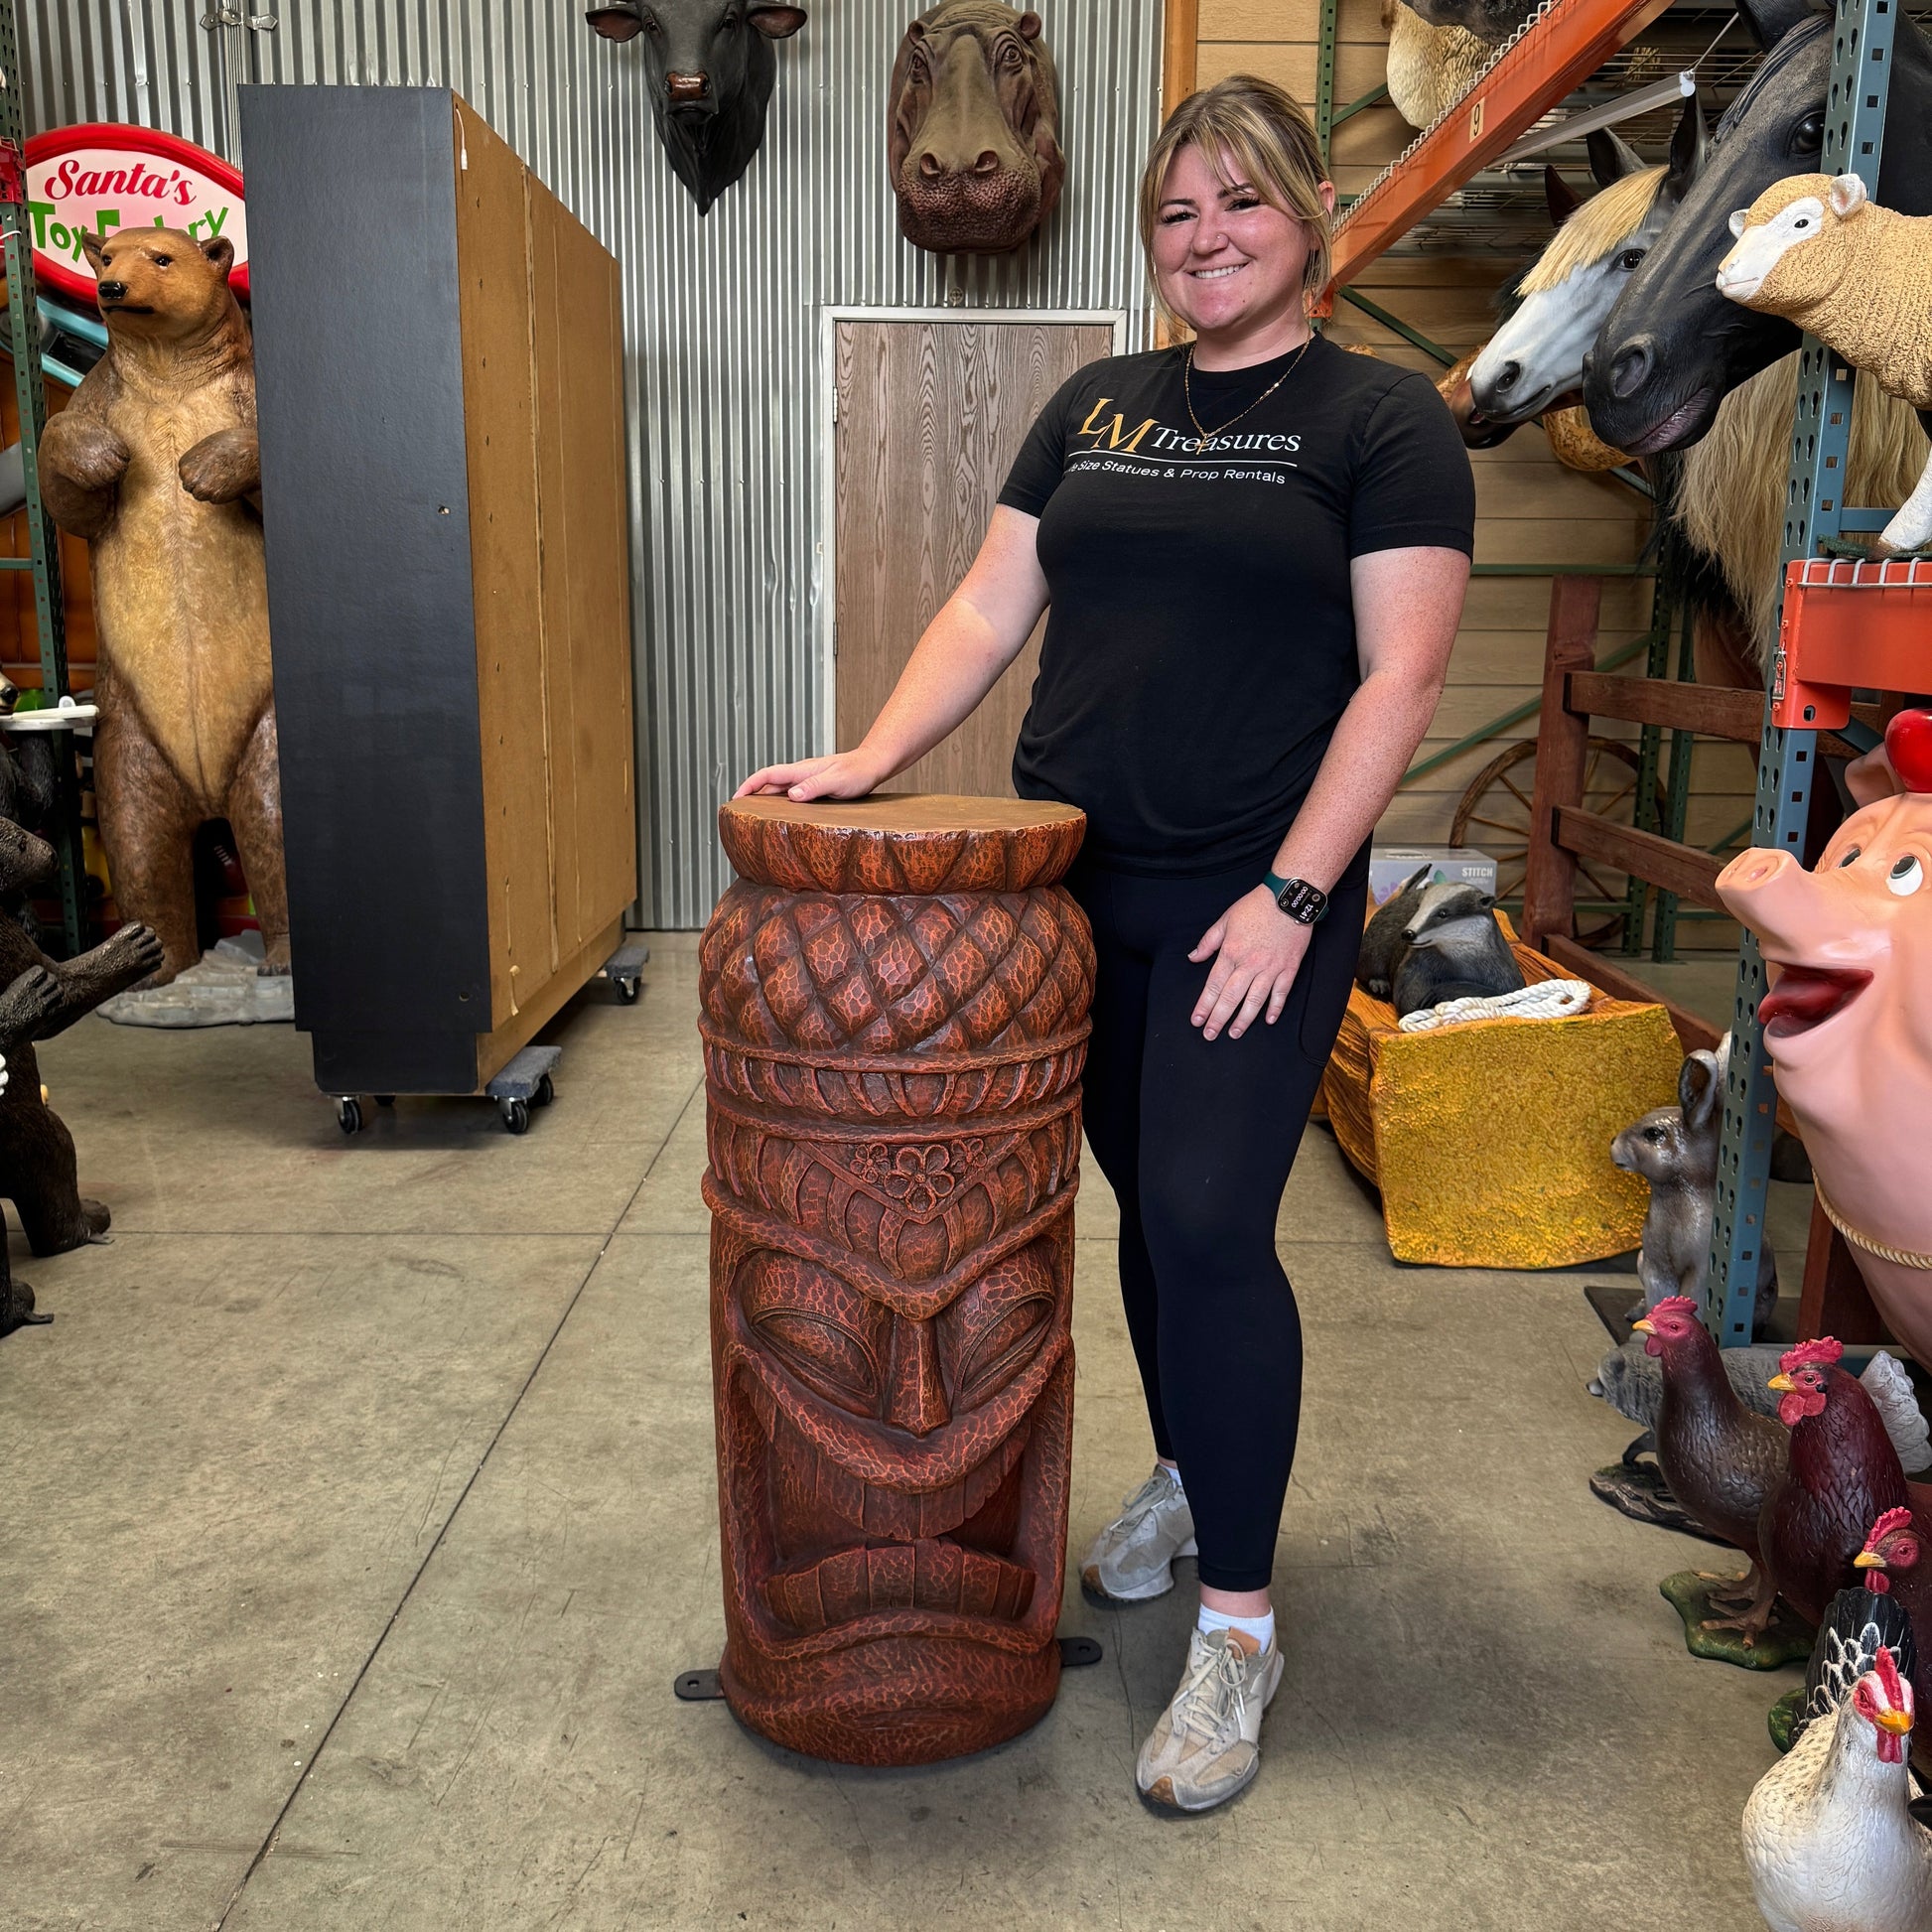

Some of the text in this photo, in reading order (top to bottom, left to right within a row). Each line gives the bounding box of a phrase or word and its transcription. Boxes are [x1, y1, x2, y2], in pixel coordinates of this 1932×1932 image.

[1473, 102, 1481, 137] 9
[45, 159, 197, 206] Santa's
[29, 201, 88, 263] Toy
[1077, 398, 1302, 453] LM Treasures
[1077, 460, 1101, 471] Size
[1101, 460, 1161, 477] Statues
[1163, 468, 1175, 479] &
[1179, 469, 1219, 481] Prop
[1223, 469, 1286, 484] Rentals
[1461, 867, 1493, 878] STITCH
